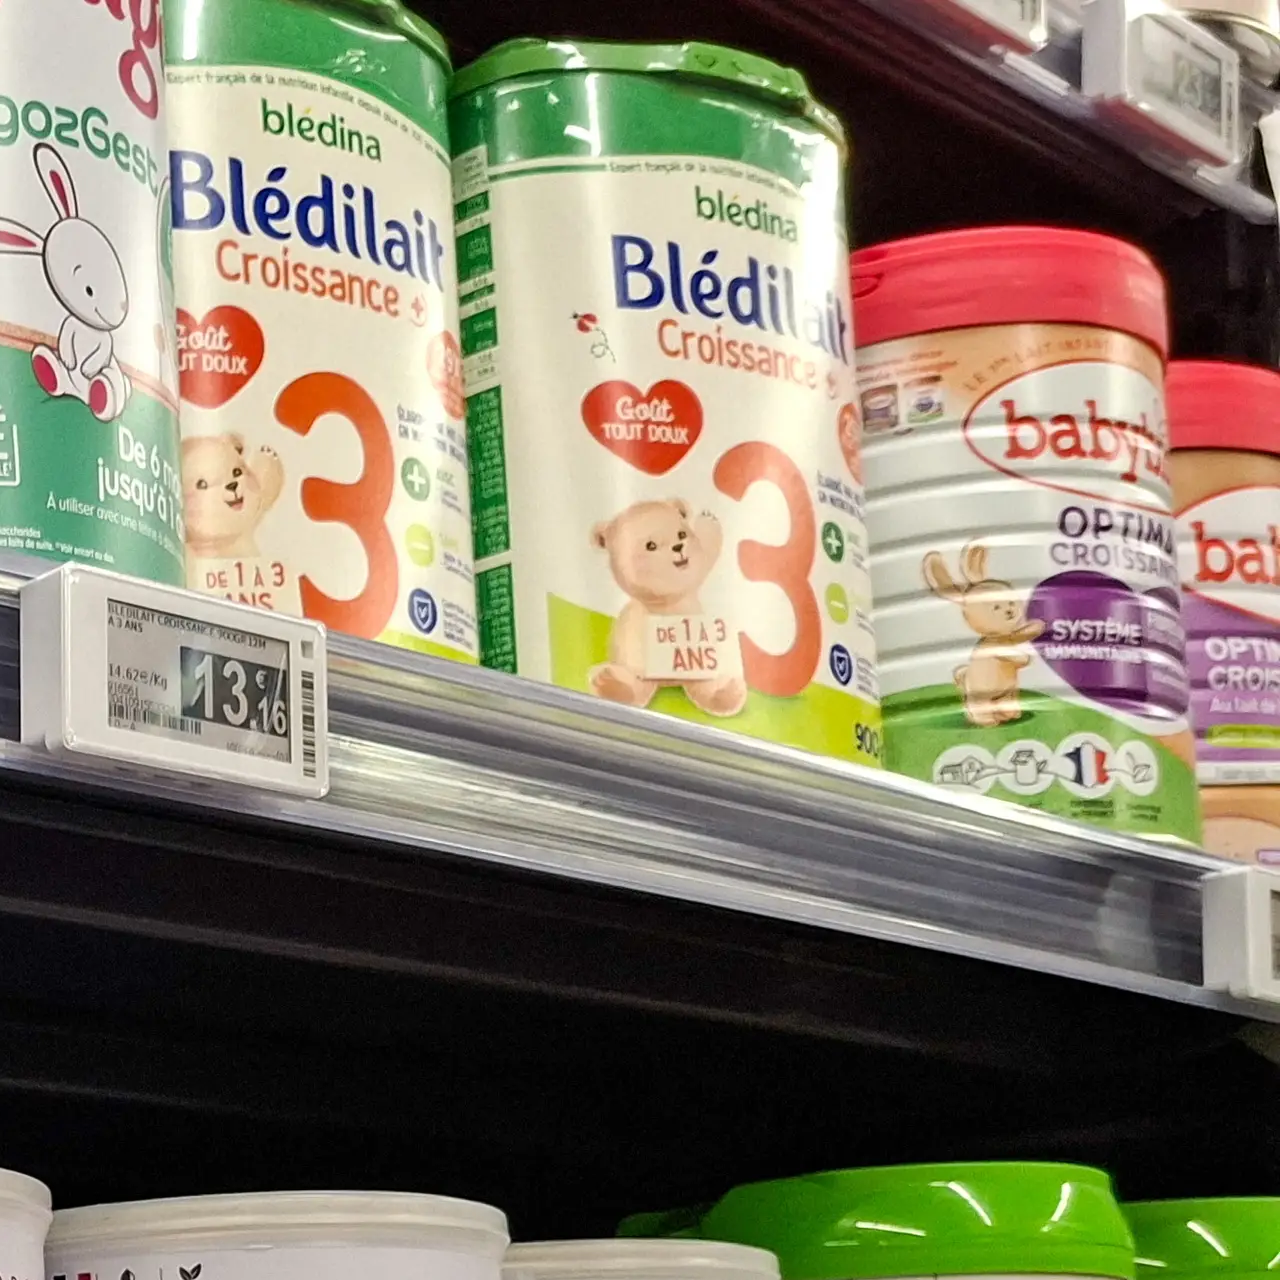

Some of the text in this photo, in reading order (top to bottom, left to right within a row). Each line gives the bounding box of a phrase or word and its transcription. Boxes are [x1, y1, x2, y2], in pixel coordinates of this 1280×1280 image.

[261, 99, 382, 161] blédina
[169, 150, 445, 292] Blédilait
[694, 186, 799, 244] blédina
[215, 242, 399, 318] Croissance
[201, 354, 248, 375] DOUX
[658, 319, 818, 389] Croissance
[616, 397, 675, 422] Goût
[118, 425, 159, 478] De 6
[602, 422, 689, 446] TOUT DOUX
[59, 498, 120, 524] utiliser avec
[274, 372, 396, 639] 3
[206, 571, 227, 588] DE
[235, 562, 243, 586] 1
[271, 562, 284, 587] 3
[712, 441, 822, 697] 3
[656, 626, 678, 645] DE
[683, 618, 692, 644] 1
[715, 618, 728, 641] 3
[1053, 616, 1142, 644] SYSTÈME
[672, 646, 719, 672] ANS
